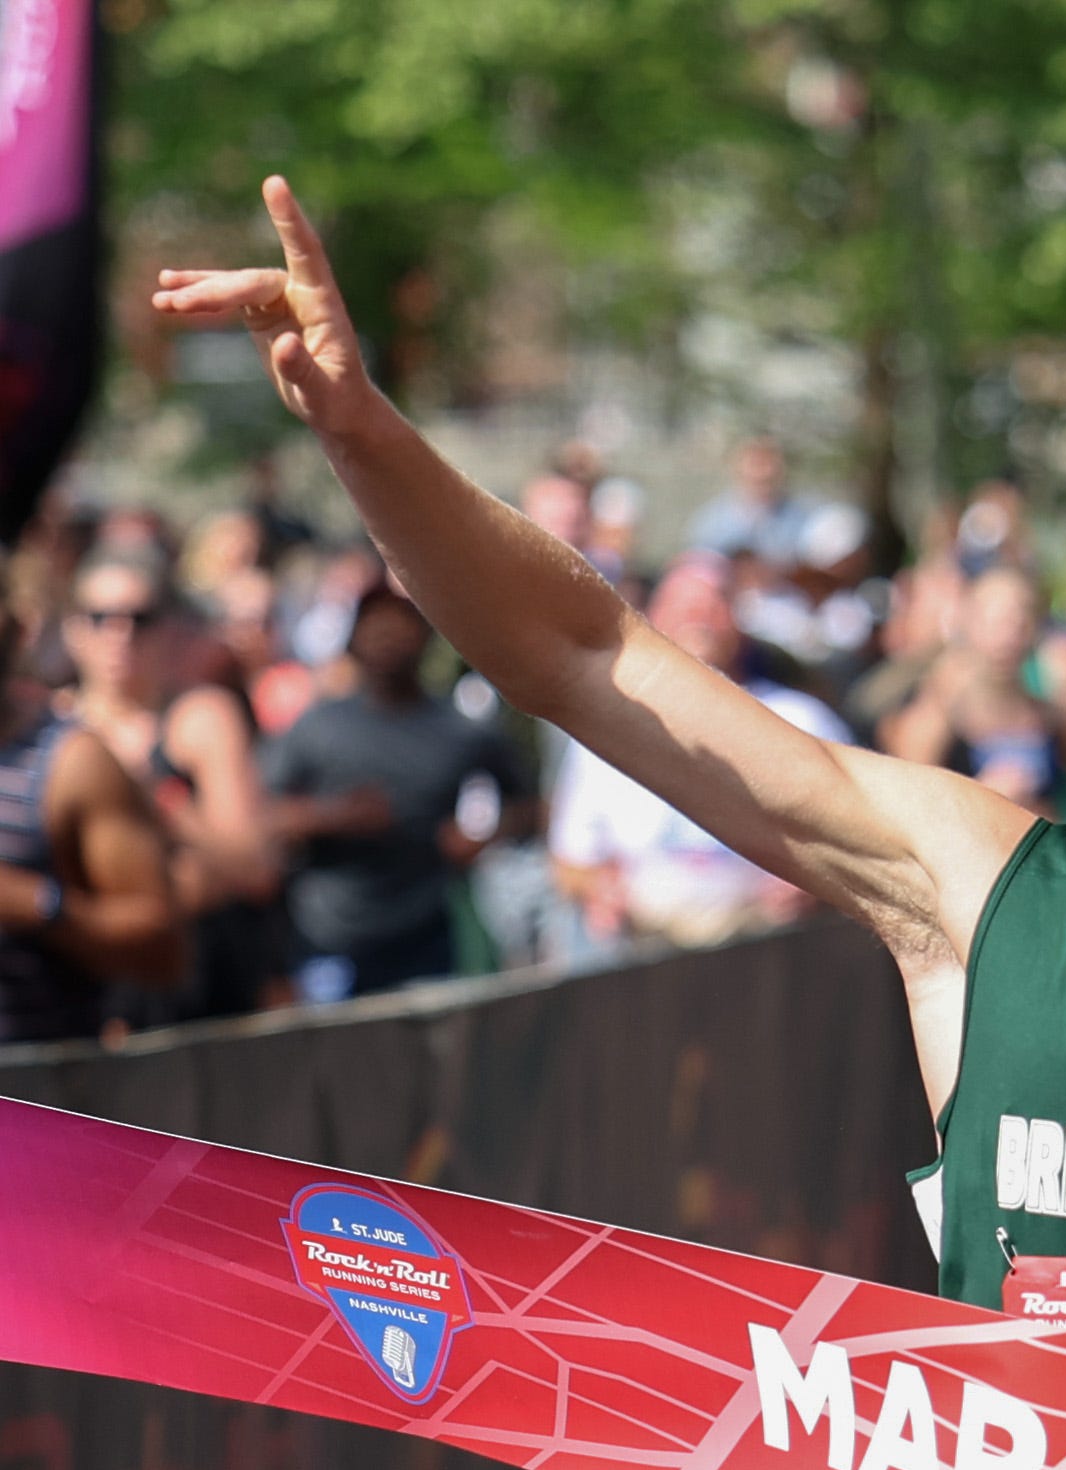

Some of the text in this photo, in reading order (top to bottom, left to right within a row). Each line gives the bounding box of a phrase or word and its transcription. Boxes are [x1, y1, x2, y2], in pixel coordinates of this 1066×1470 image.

[350, 1223, 407, 1246] ST. JUDE
[302, 1240, 374, 1272] Rock
[391, 1259, 451, 1290] Roll
[321, 1266, 441, 1301] RUNNING SERIES
[348, 1297, 428, 1324] NASHVILLE
